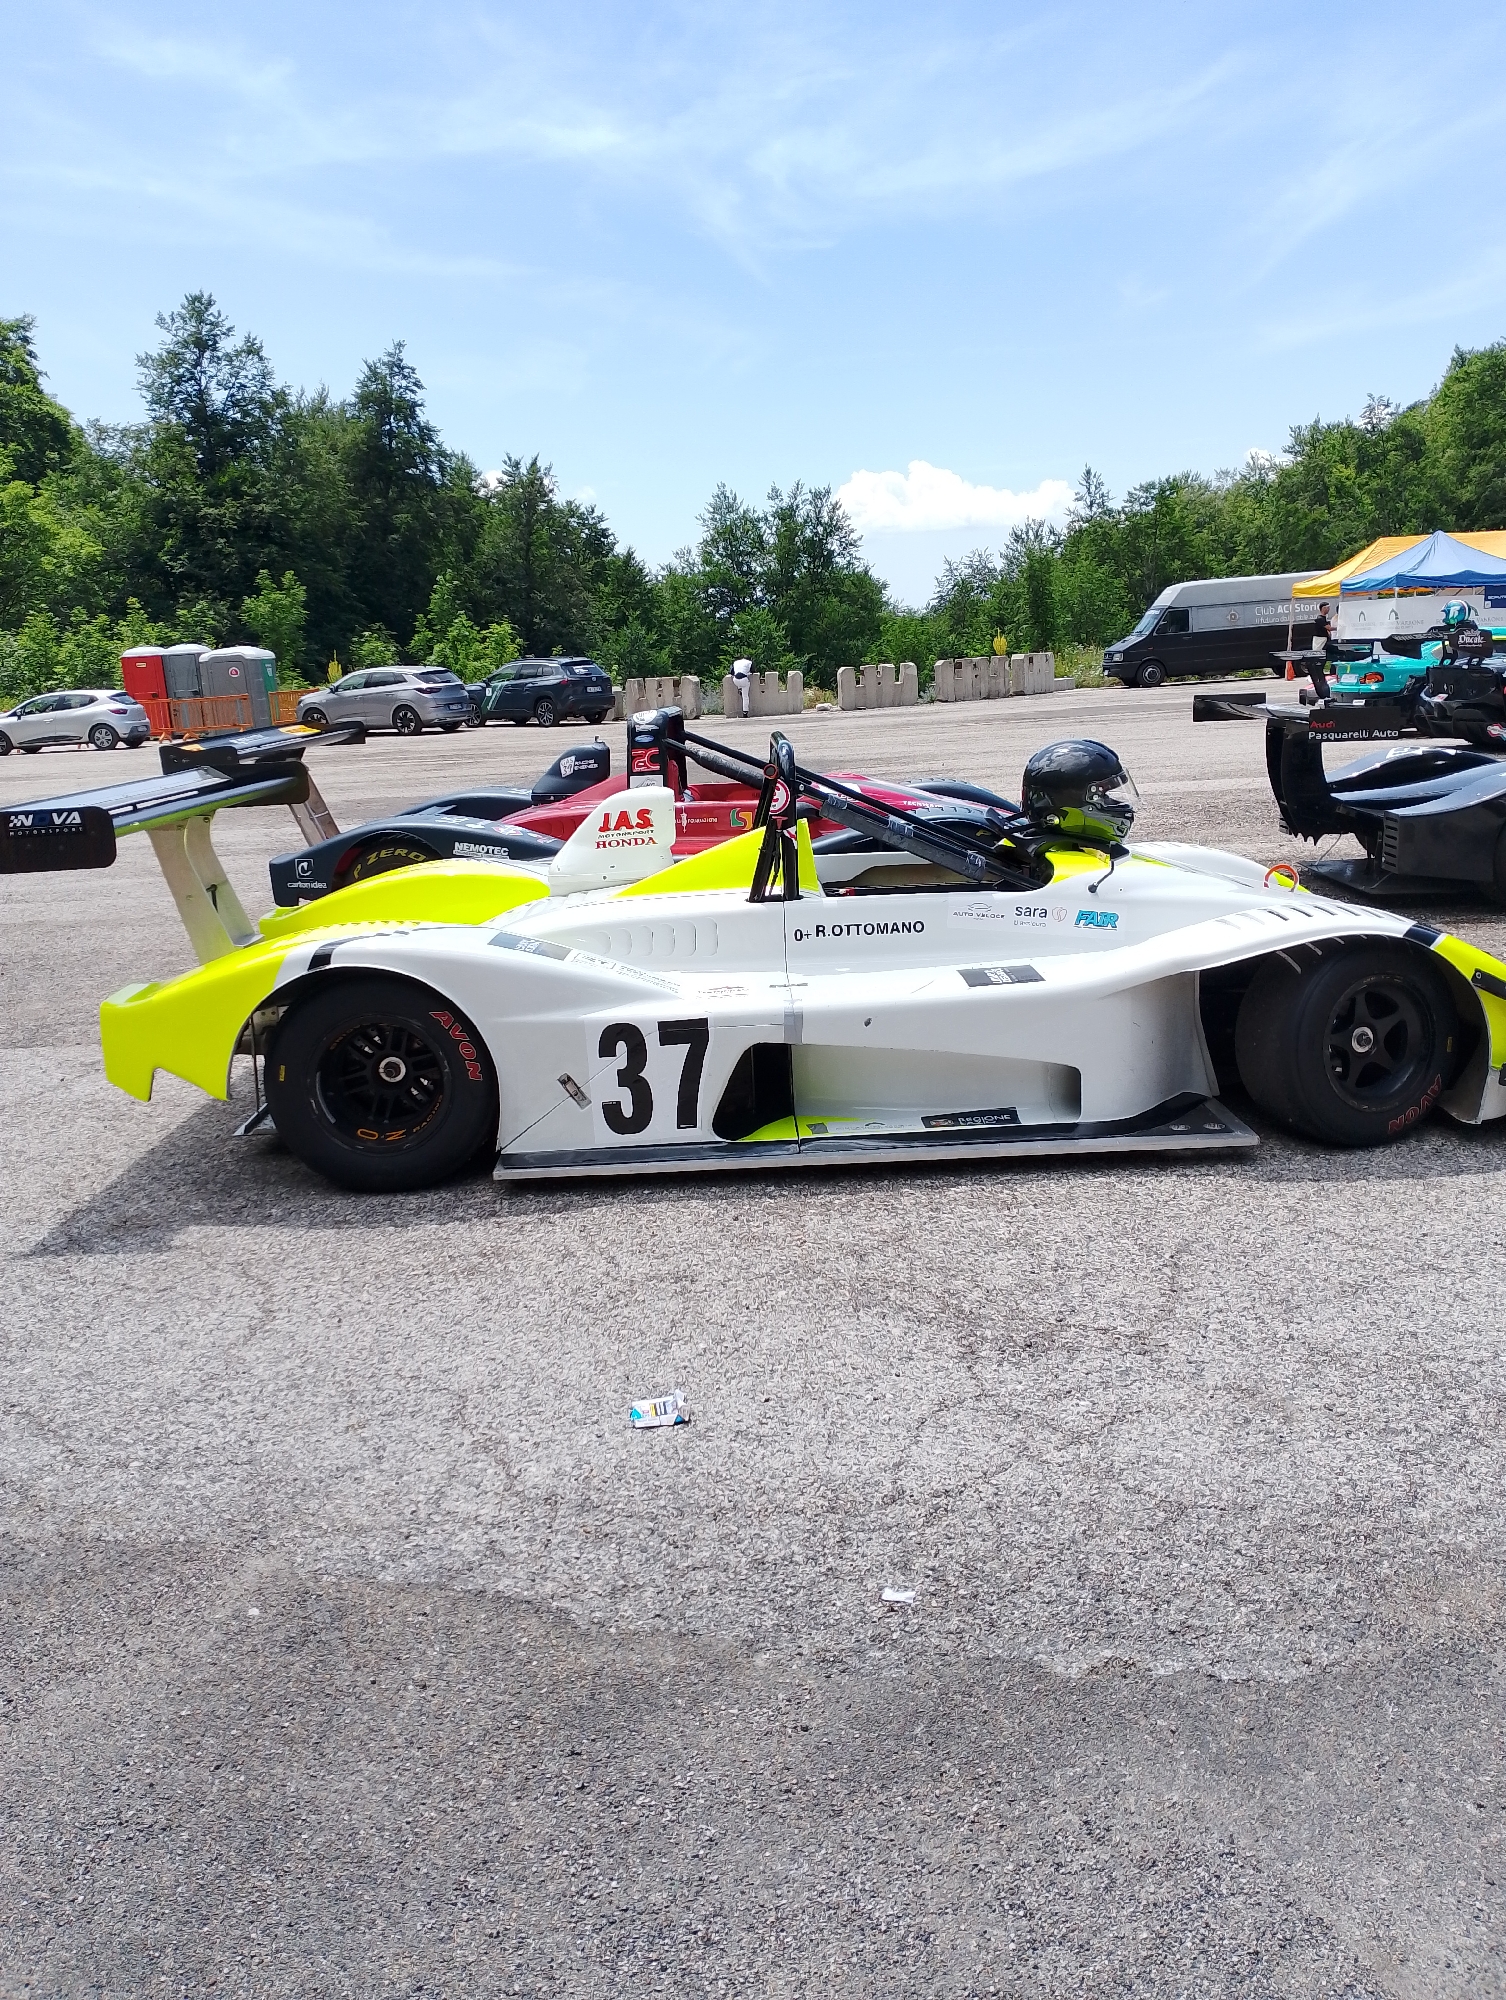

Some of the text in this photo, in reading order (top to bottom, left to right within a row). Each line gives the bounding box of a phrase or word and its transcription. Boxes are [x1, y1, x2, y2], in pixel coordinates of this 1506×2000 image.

[1255, 605, 1275, 616] Club
[1310, 720, 1336, 729] Audi
[1309, 729, 1399, 740] Pasquarelli Auto
[598, 808, 654, 832] JAS
[454, 841, 510, 856] NEMOTEC
[595, 836, 659, 850] HONDA
[366, 848, 427, 866] ZERO
[1014, 906, 1048, 919] sara
[1075, 909, 1120, 930] FAIR
[815, 920, 926, 938] R.OTTOMANO
[428, 1010, 483, 1082] AVON
[598, 1017, 710, 1135] 37
[1387, 1073, 1442, 1135] AVON
